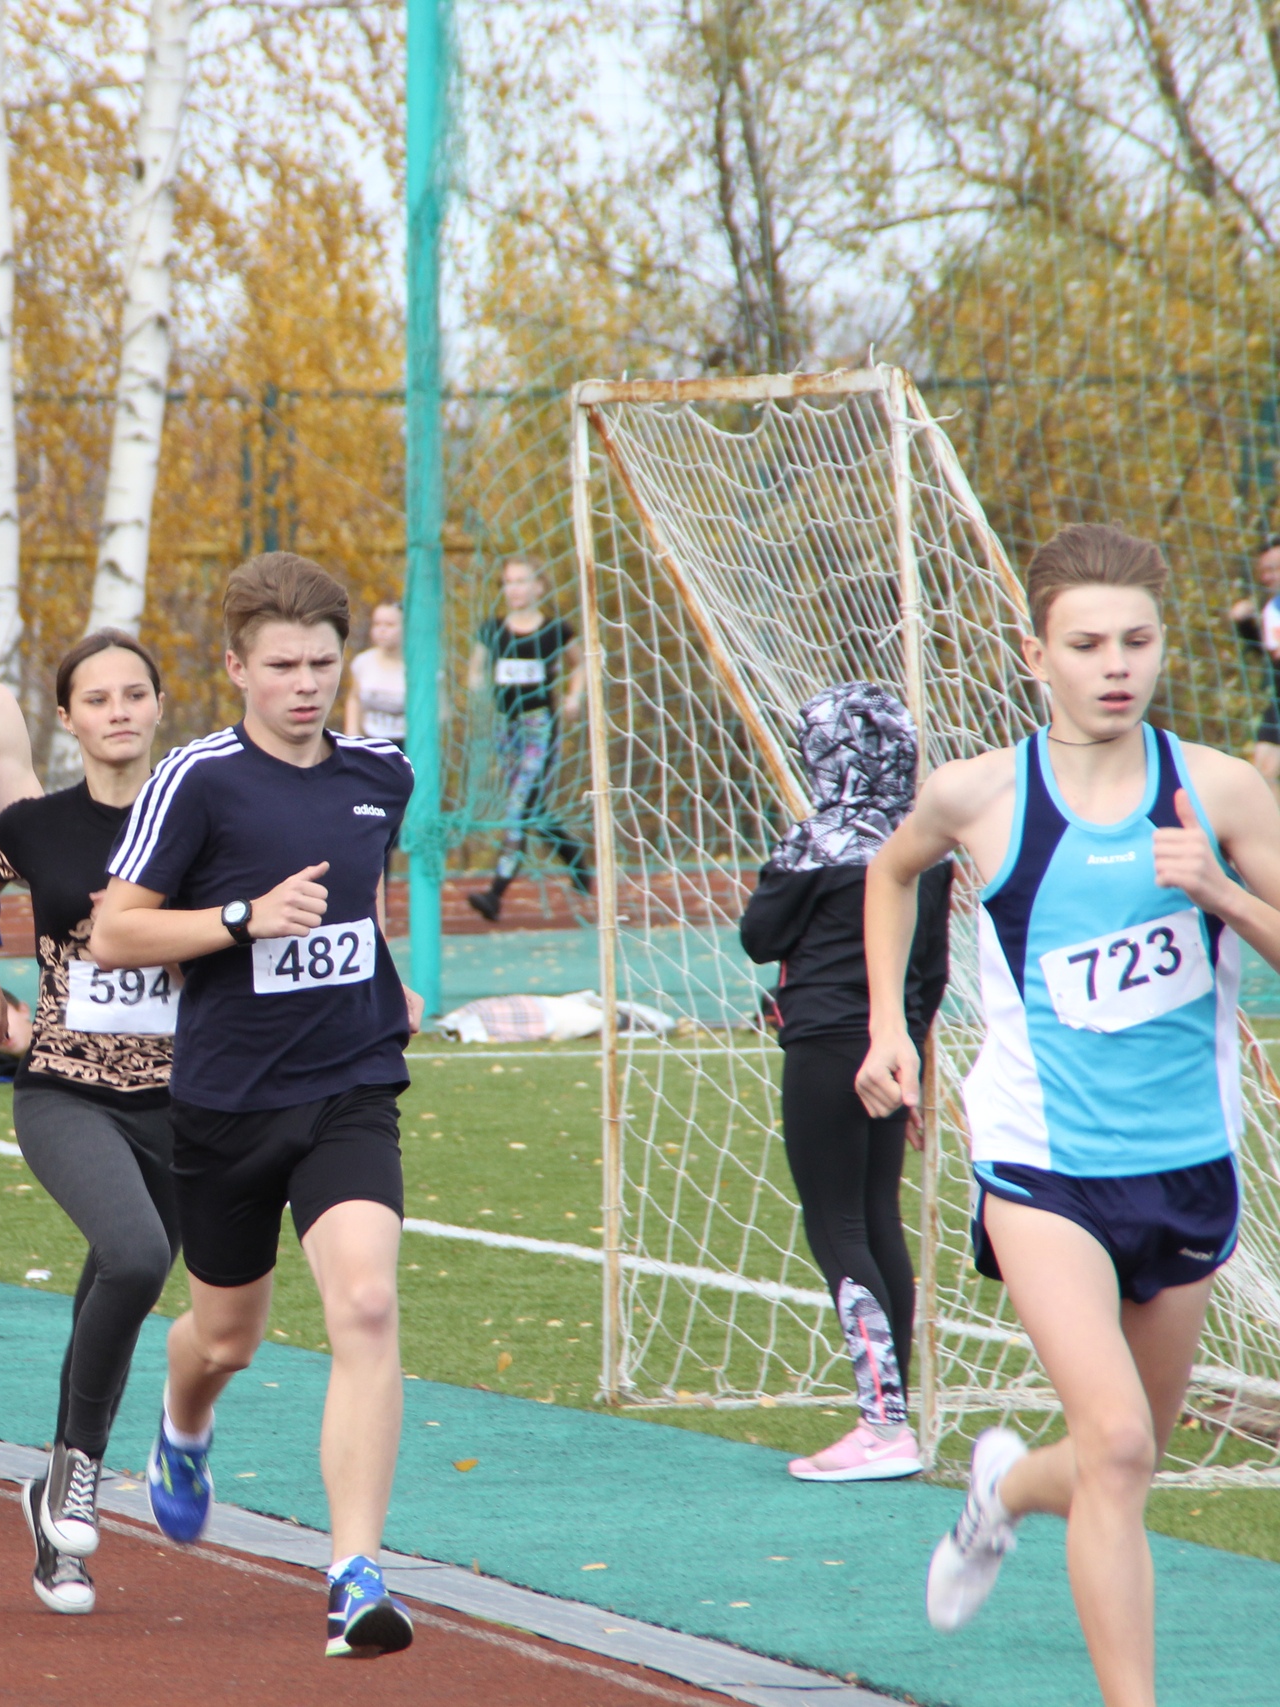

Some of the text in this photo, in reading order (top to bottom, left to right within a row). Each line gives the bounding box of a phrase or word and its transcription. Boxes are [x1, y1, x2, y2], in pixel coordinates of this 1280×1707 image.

[353, 803, 386, 817] adidas
[275, 931, 361, 982] 482
[1067, 926, 1182, 1002] 723
[89, 966, 171, 1006] 594
